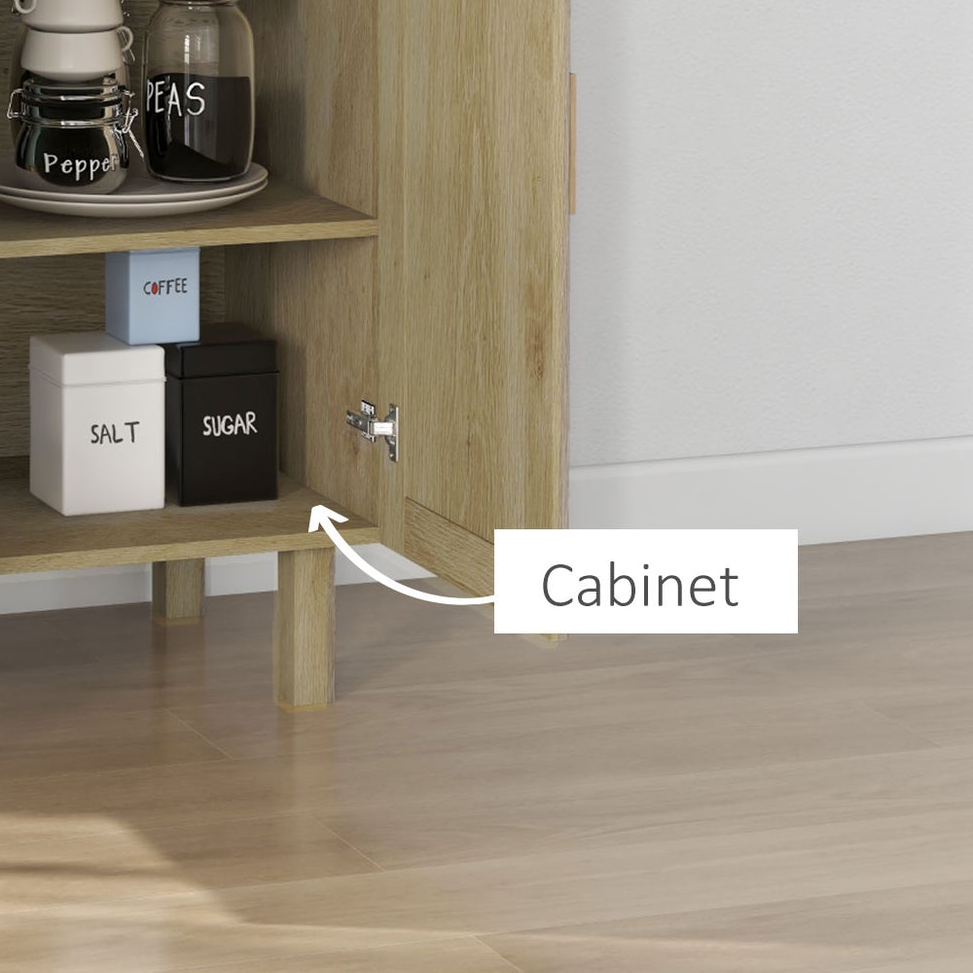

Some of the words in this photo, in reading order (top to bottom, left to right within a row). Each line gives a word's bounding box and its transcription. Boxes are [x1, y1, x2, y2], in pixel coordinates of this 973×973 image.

[146, 79, 205, 117] PEAS
[143, 277, 188, 295] COFFEE
[90, 421, 140, 444] SALT
[203, 411, 258, 437] SUGAR
